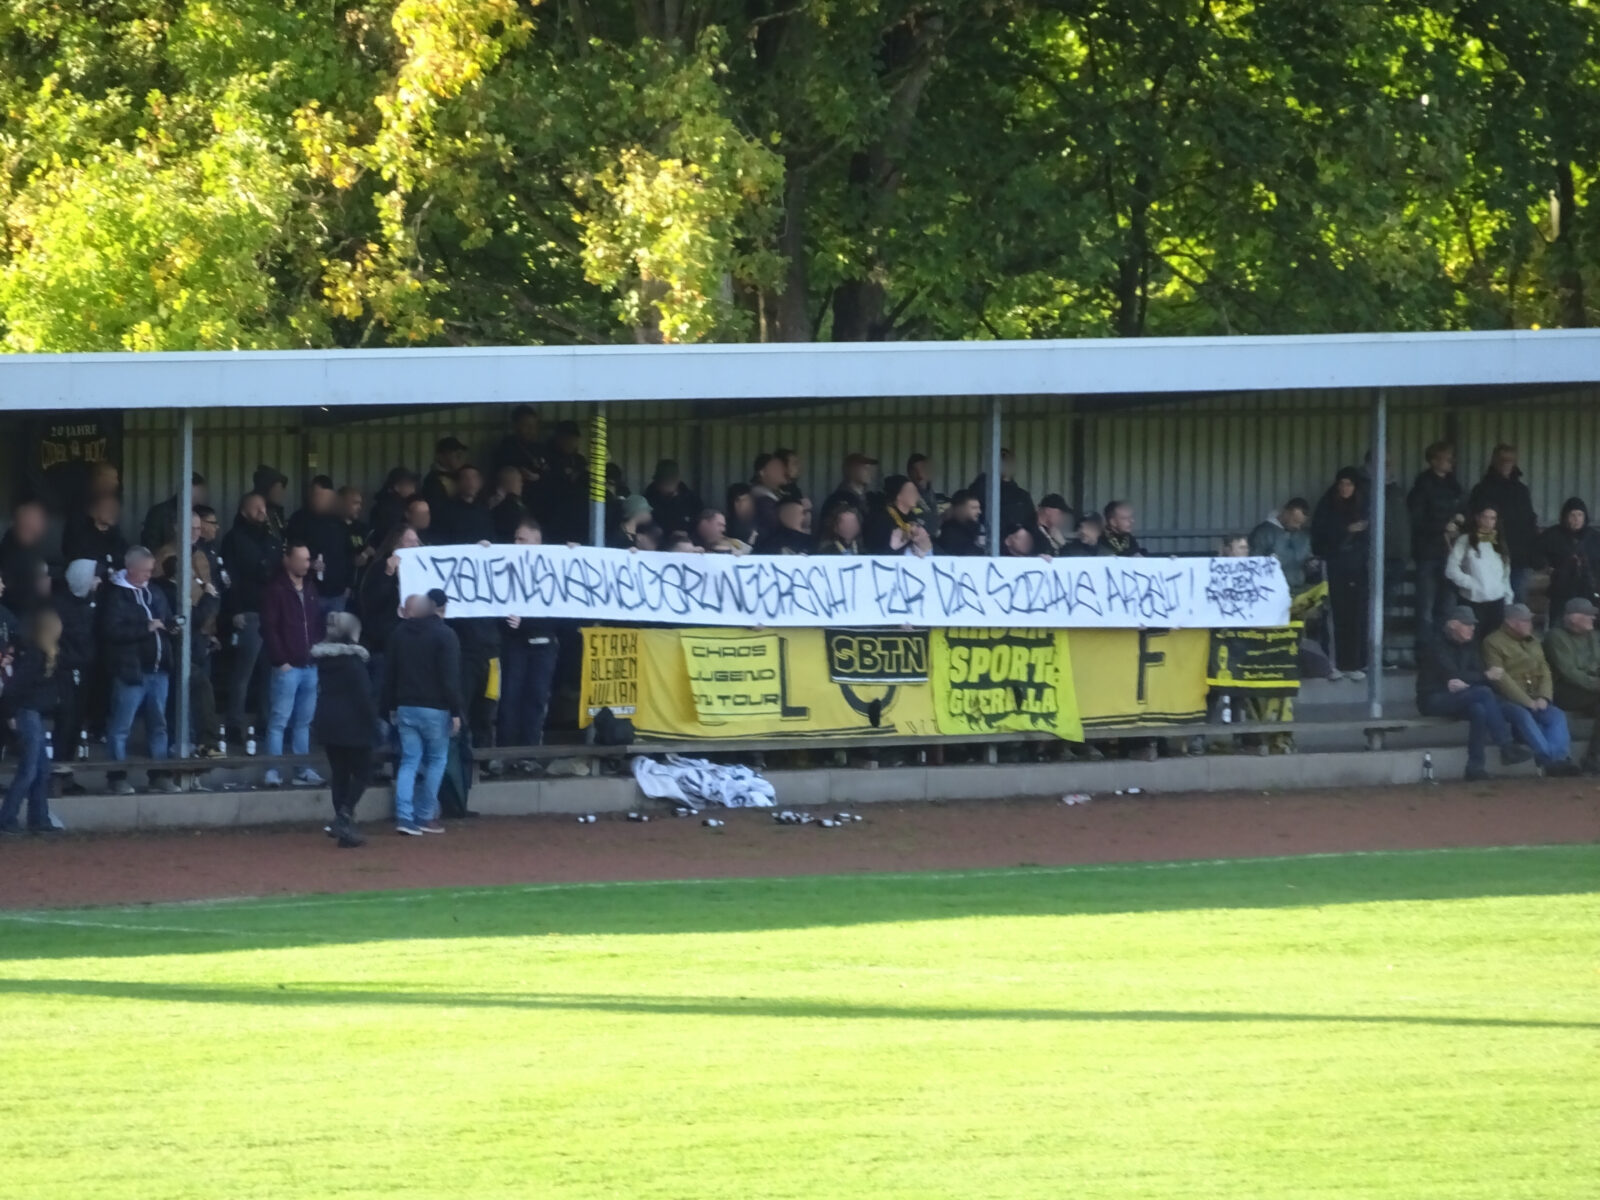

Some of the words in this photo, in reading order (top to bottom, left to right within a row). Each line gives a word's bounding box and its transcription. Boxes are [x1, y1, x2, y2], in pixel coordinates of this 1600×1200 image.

[65, 423, 97, 438] JAHRE
[932, 561, 985, 617] DIE
[986, 559, 1103, 616] SOZIALE
[589, 632, 638, 656] STARK
[691, 644, 767, 659] CHAOS
[832, 634, 928, 674] SBTN
[590, 656, 638, 681] BLEIBEN
[588, 681, 638, 706] JULIAN
[716, 693, 780, 708] TOUR
